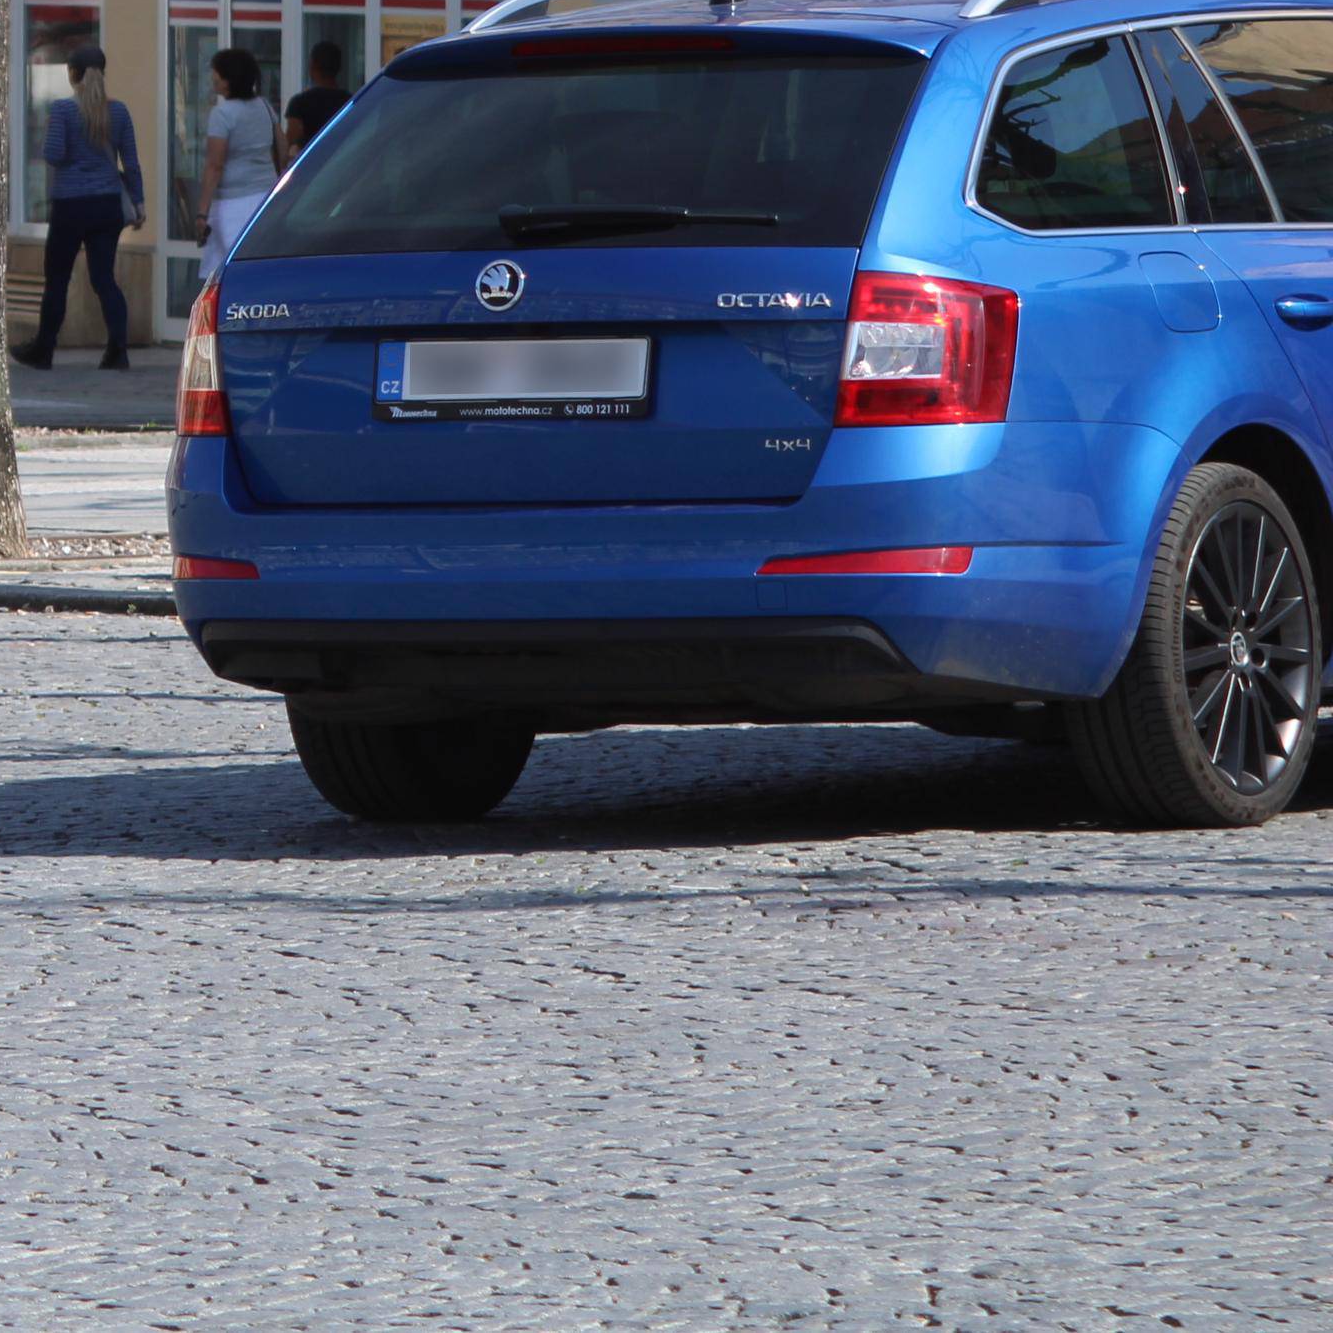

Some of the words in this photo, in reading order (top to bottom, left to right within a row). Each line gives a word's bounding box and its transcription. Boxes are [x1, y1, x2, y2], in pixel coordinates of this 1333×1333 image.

[717, 292, 832, 308] OCTAVIA
[226, 303, 290, 320] ŠKODA
[380, 380, 400, 395] CZ
[459, 406, 553, 417] www.mototechna.cz
[576, 405, 593, 415] 800
[595, 405, 611, 415] 121
[614, 404, 630, 415] 111
[765, 438, 811, 452] 4x4
